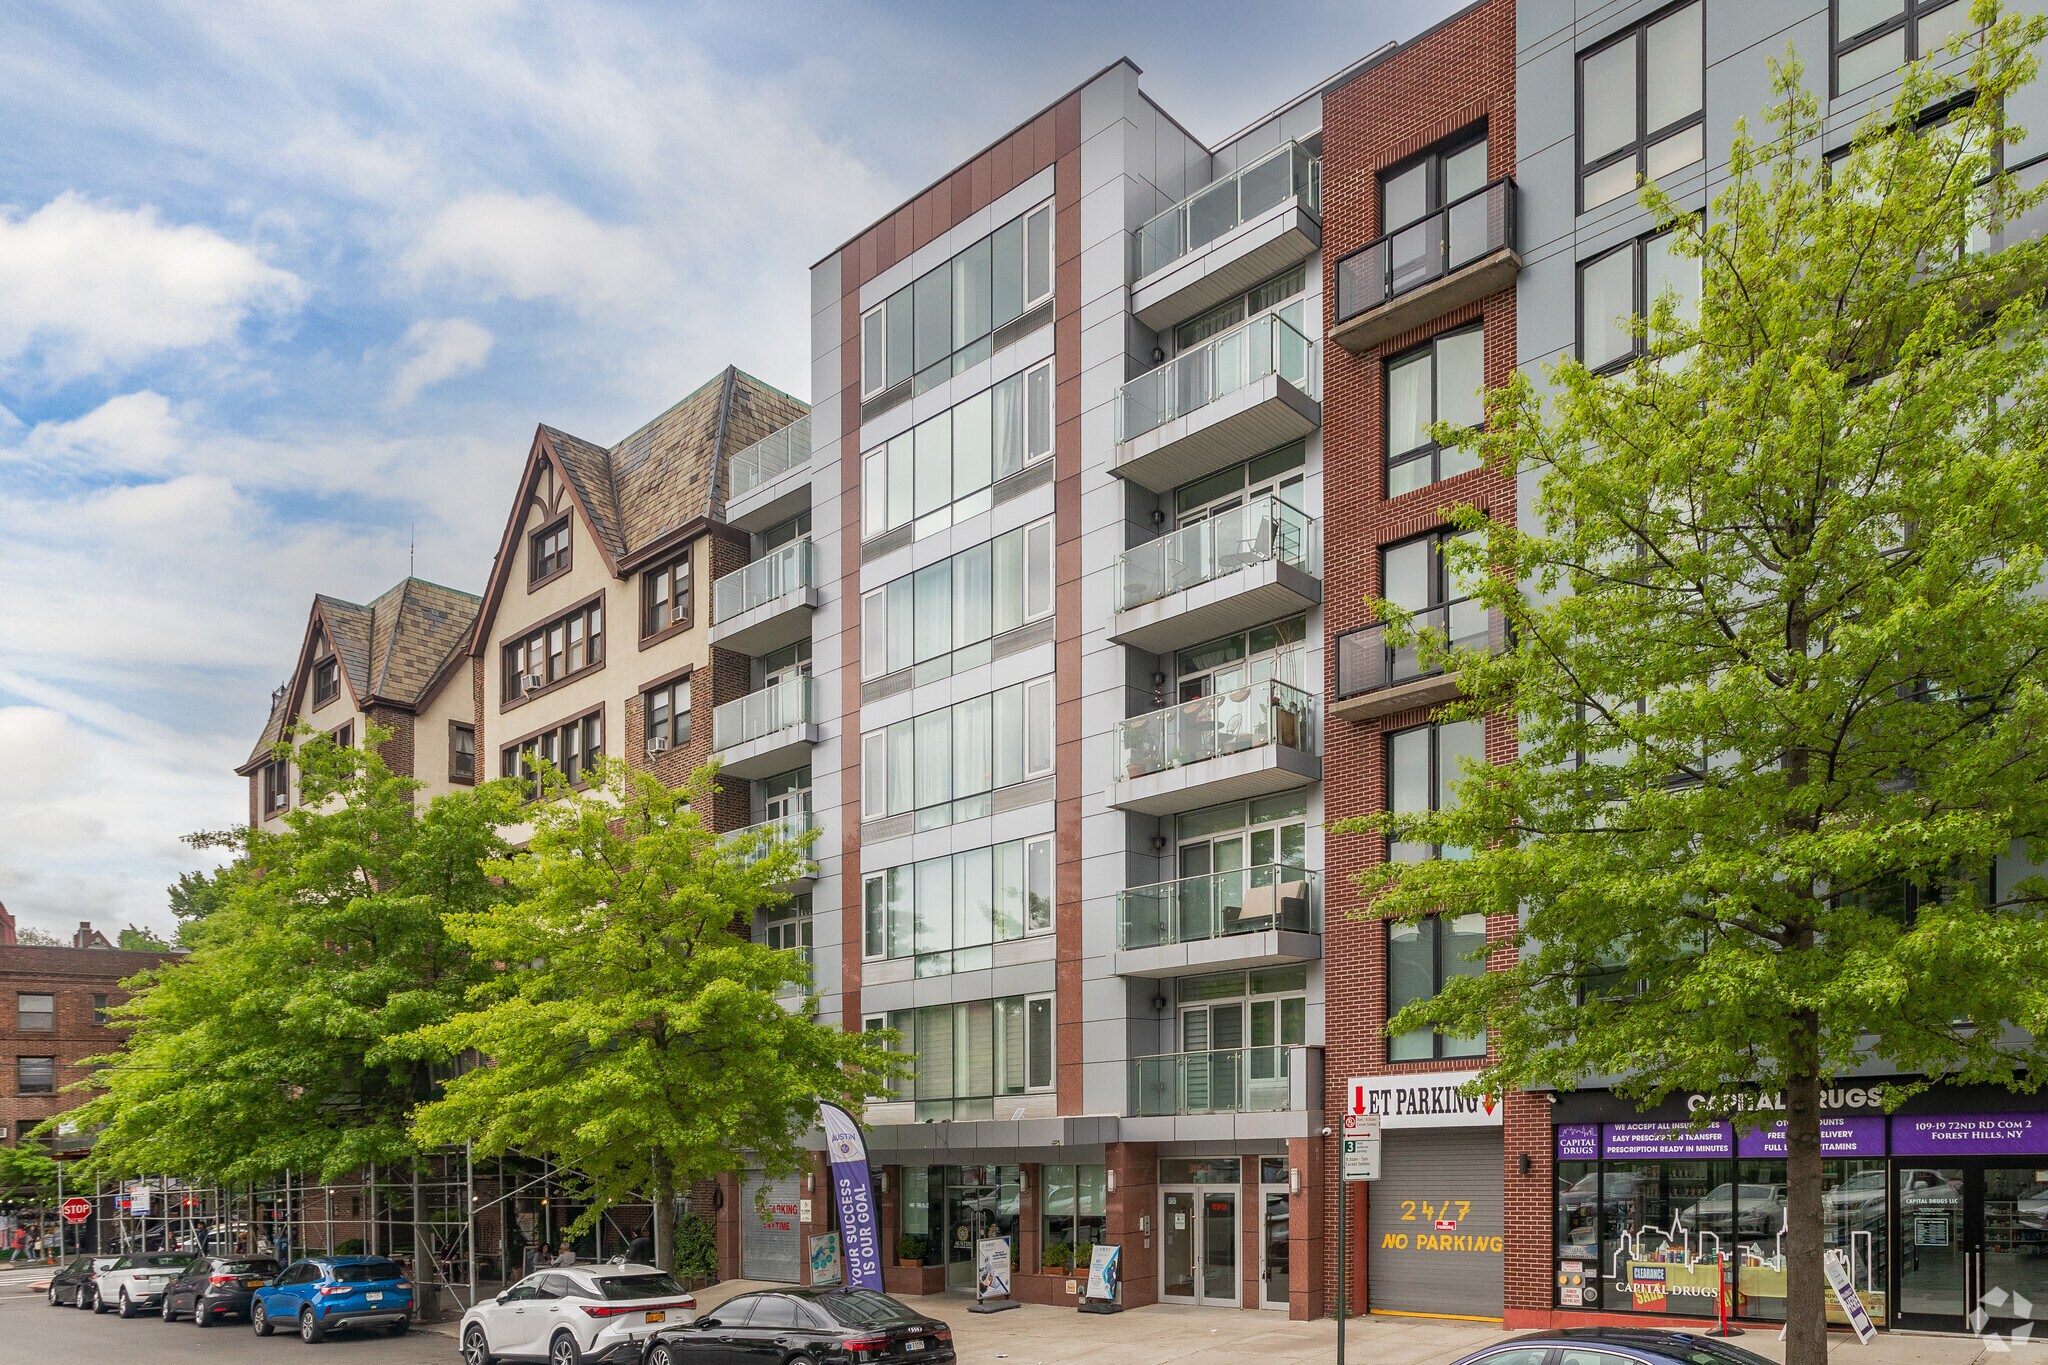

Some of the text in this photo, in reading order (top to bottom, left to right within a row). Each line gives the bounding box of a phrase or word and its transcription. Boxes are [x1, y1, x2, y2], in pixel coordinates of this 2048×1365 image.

[1369, 1086, 1479, 1116] ET PARKING
[1820, 1087, 1883, 1109] RUGS
[1626, 1123, 1656, 1131] ACCEPT
[1672, 1121, 1720, 1130] INSURES
[1915, 1122, 1946, 1131] 109-19
[1948, 1122, 1976, 1130] 72ND
[1978, 1121, 1995, 1129] RD
[2025, 1120, 2032, 1128] 2
[1632, 1134, 1684, 1142] PRESCRIPTIN
[1685, 1133, 1722, 1141] TRANSFER
[1767, 1130, 1854, 1139] FREE ELIVERY
[2007, 1130, 2024, 1139] NY
[1347, 1141, 1354, 1153] 3
[1560, 1138, 1597, 1147] CAPITAL
[1820, 1142, 1857, 1151] ITAMINS
[1563, 1147, 1594, 1155] DRUGS
[1607, 1146, 1658, 1154] PRESCRIPTION
[1685, 1145, 1694, 1153] IN
[64, 1204, 89, 1215] STOP
[839, 1178, 863, 1287] YOUR SUCCESS
[854, 1183, 876, 1276] IS OUR GOAL
[1381, 1233, 1503, 1252] NO PARKING
[1633, 1267, 1665, 1280] CLEARANCE
[1615, 1282, 1718, 1298] CAPITAL DRUGS
